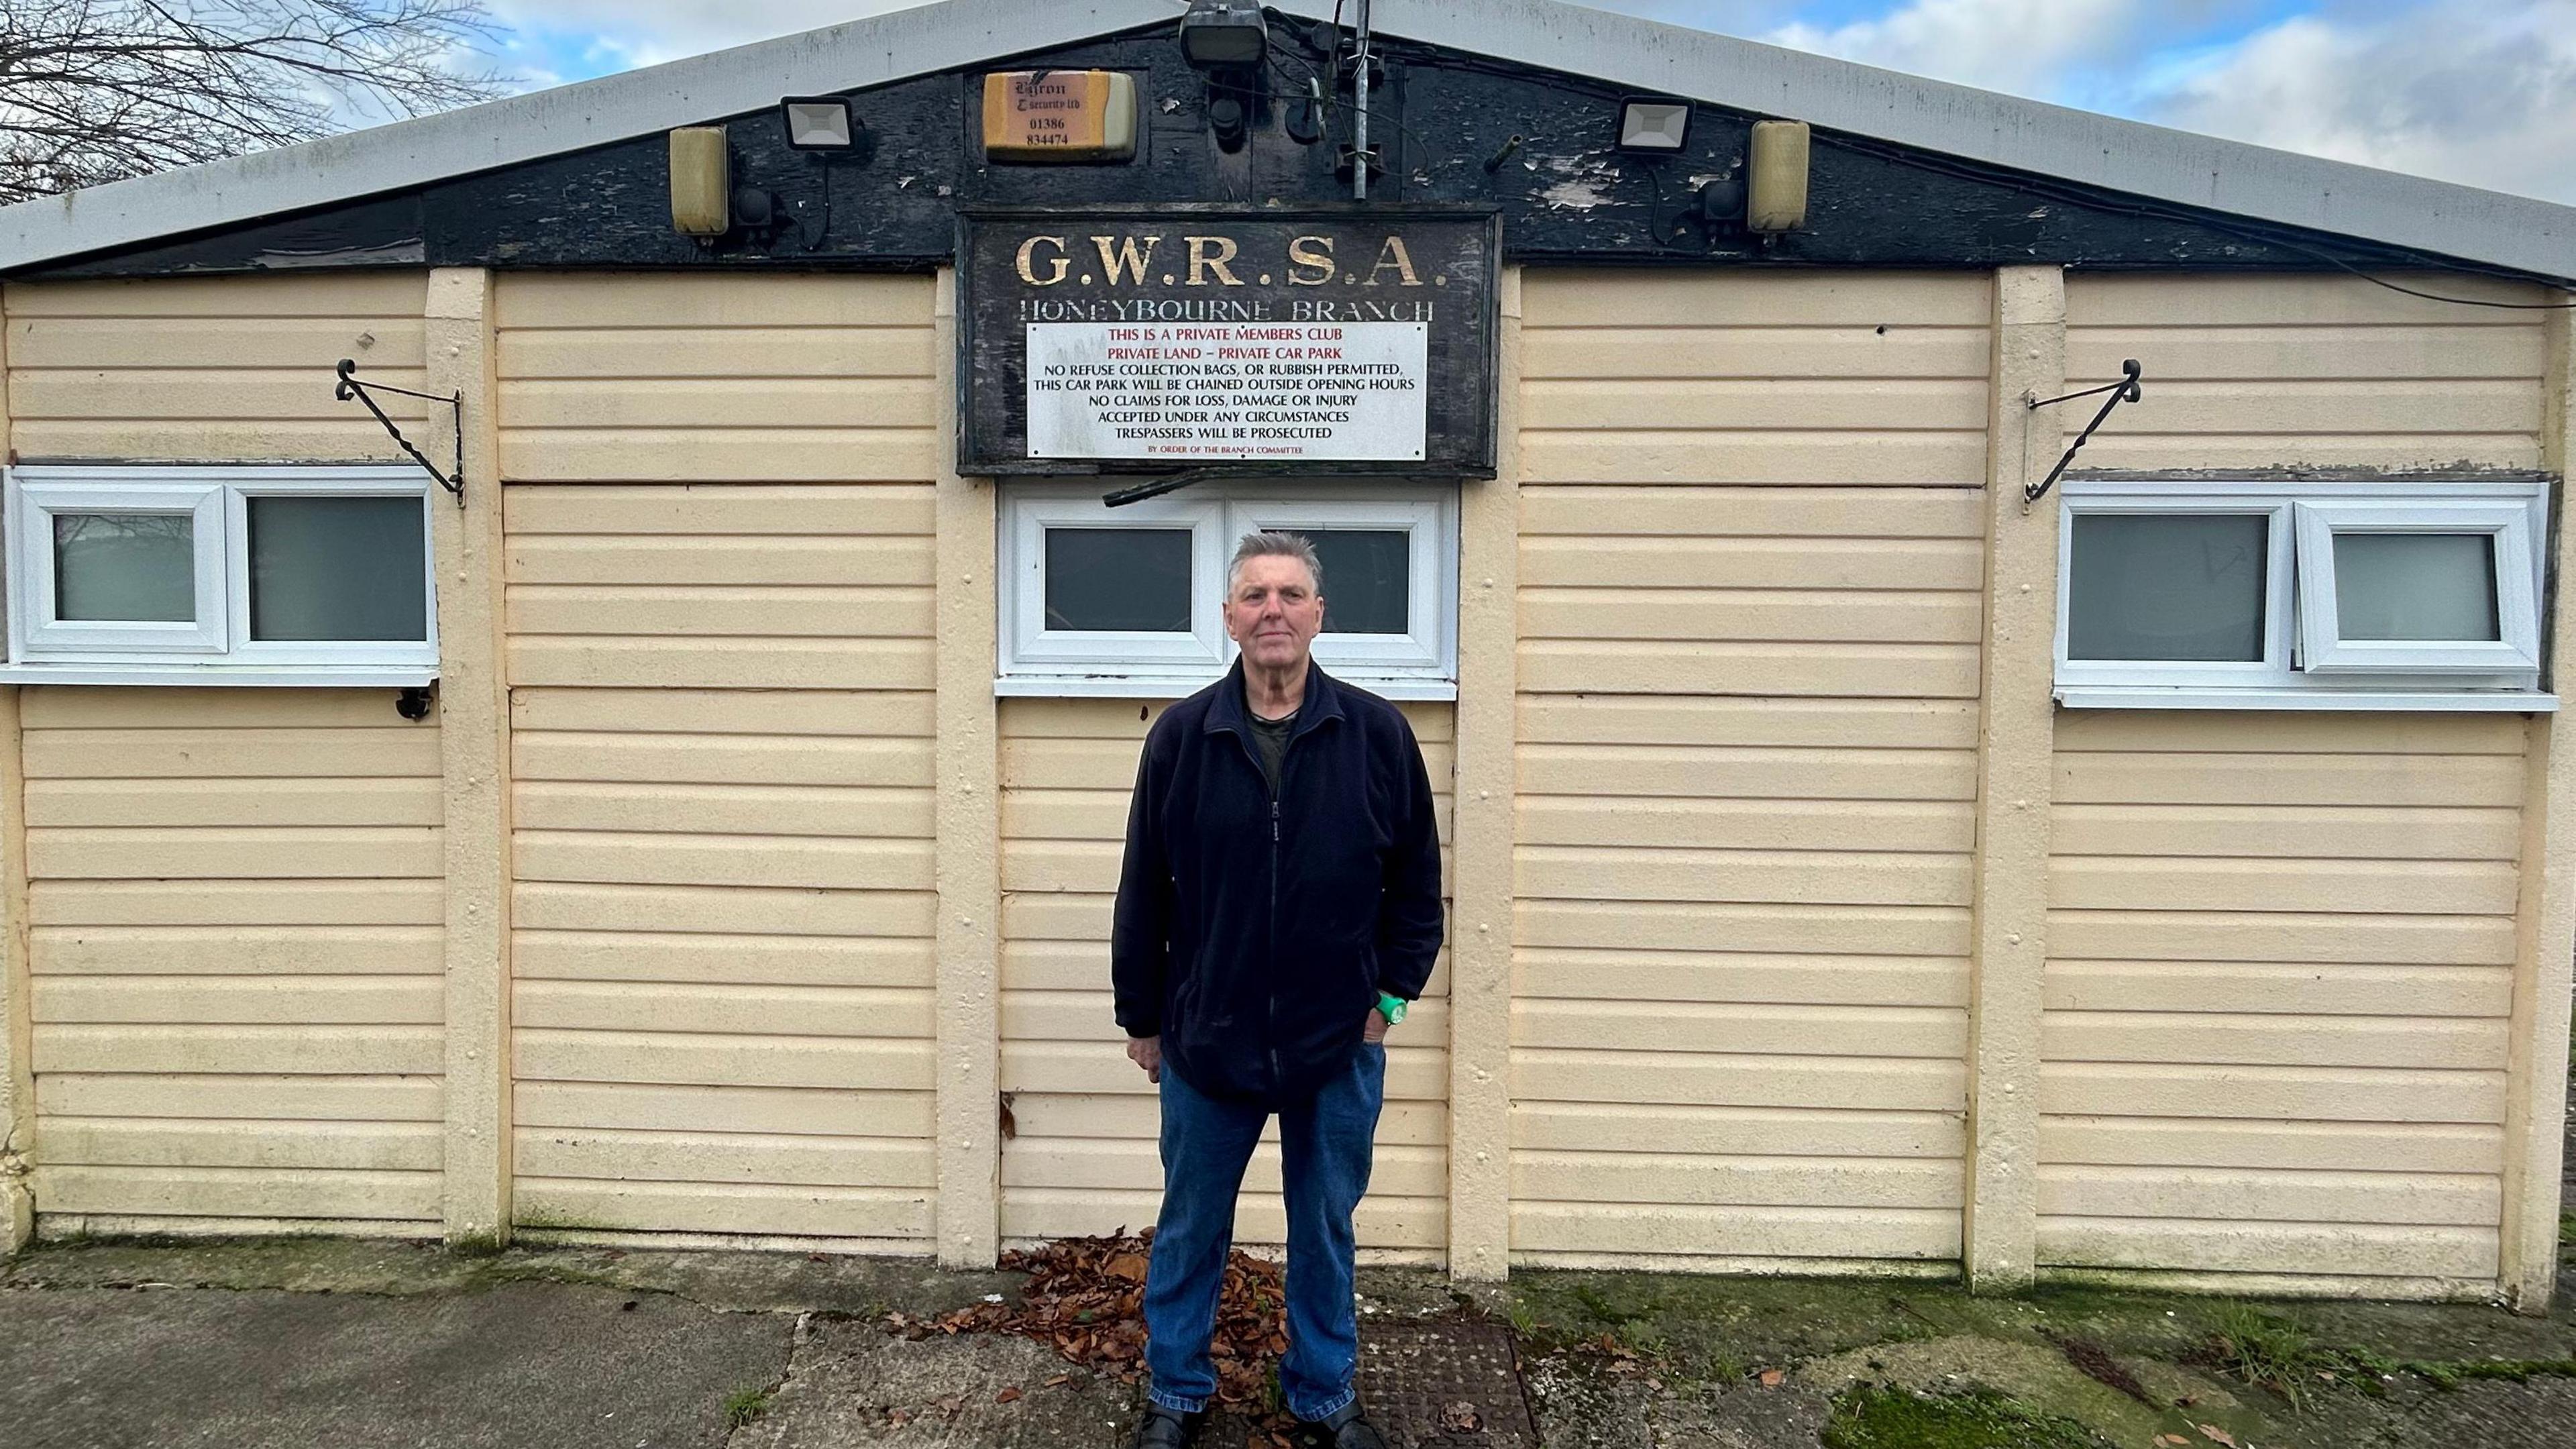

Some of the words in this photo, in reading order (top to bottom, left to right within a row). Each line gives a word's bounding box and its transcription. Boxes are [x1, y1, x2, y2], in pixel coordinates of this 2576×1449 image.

[1030, 118, 1065, 129] 01386
[1027, 134, 1068, 146] 834474
[1020, 300, 1272, 321] HONEYBOURNE
[1292, 301, 1434, 321] BRANCH
[1108, 328, 1139, 341] THIS
[1144, 328, 1156, 341] IS
[1161, 328, 1171, 340] A
[1176, 328, 1230, 341] PRIVATE
[1235, 328, 1303, 341] MEMBERS
[1307, 327, 1342, 341] CLUB
[1108, 347, 1160, 360] PRIVATE
[1164, 347, 1201, 360] LAND
[1218, 347, 1271, 360] PRIVATE
[1275, 347, 1303, 360] CAR
[1308, 347, 1342, 360] PARK
[1044, 364, 1066, 376] NO
[1069, 364, 1115, 376] REFUSE
[1119, 364, 1201, 376] COLLECTION
[1204, 364, 1240, 378] BAGS,
[1244, 364, 1264, 376] OR
[1269, 364, 1323, 376] RUBBISH
[1327, 364, 1403, 376] PERMITTED,
[1033, 379, 1061, 391] THIS
[1065, 379, 1091, 391] CAR
[1095, 379, 1128, 390] PARK
[1132, 379, 1163, 390] WILL
[1167, 379, 1181, 390] BE
[1185, 378, 1244, 390] CHAINED
[1248, 378, 1303, 390] OUTSIDE
[1307, 378, 1365, 390] OPENING
[1369, 378, 1415, 390] HOURS
[1089, 394, 1110, 407] NO
[1114, 394, 1161, 407] CLAIMS
[1165, 394, 1191, 407] FOR
[1195, 394, 1229, 409] LOSS,
[1232, 394, 1287, 407] DAMAGE
[1291, 394, 1311, 407] OR
[1316, 394, 1358, 408] INJURY
[1097, 411, 1161, 423] ACCEPTED
[1165, 411, 1209, 423] UNDER
[1213, 411, 1240, 423] ANY
[1245, 411, 1349, 423] CIRCUMSTANCES
[1115, 427, 1193, 439] TRESPASSERS
[1197, 427, 1228, 439] WILL
[1232, 427, 1247, 439] BE
[1250, 427, 1332, 439] PROSECUTED
[1147, 445, 1158, 453] BY
[1159, 445, 1188, 454] ORDER
[1189, 445, 1201, 454] OF
[1203, 445, 1218, 454] THE
[1220, 445, 1254, 454] BRANCH
[1255, 445, 1303, 455] COMMITTEE
